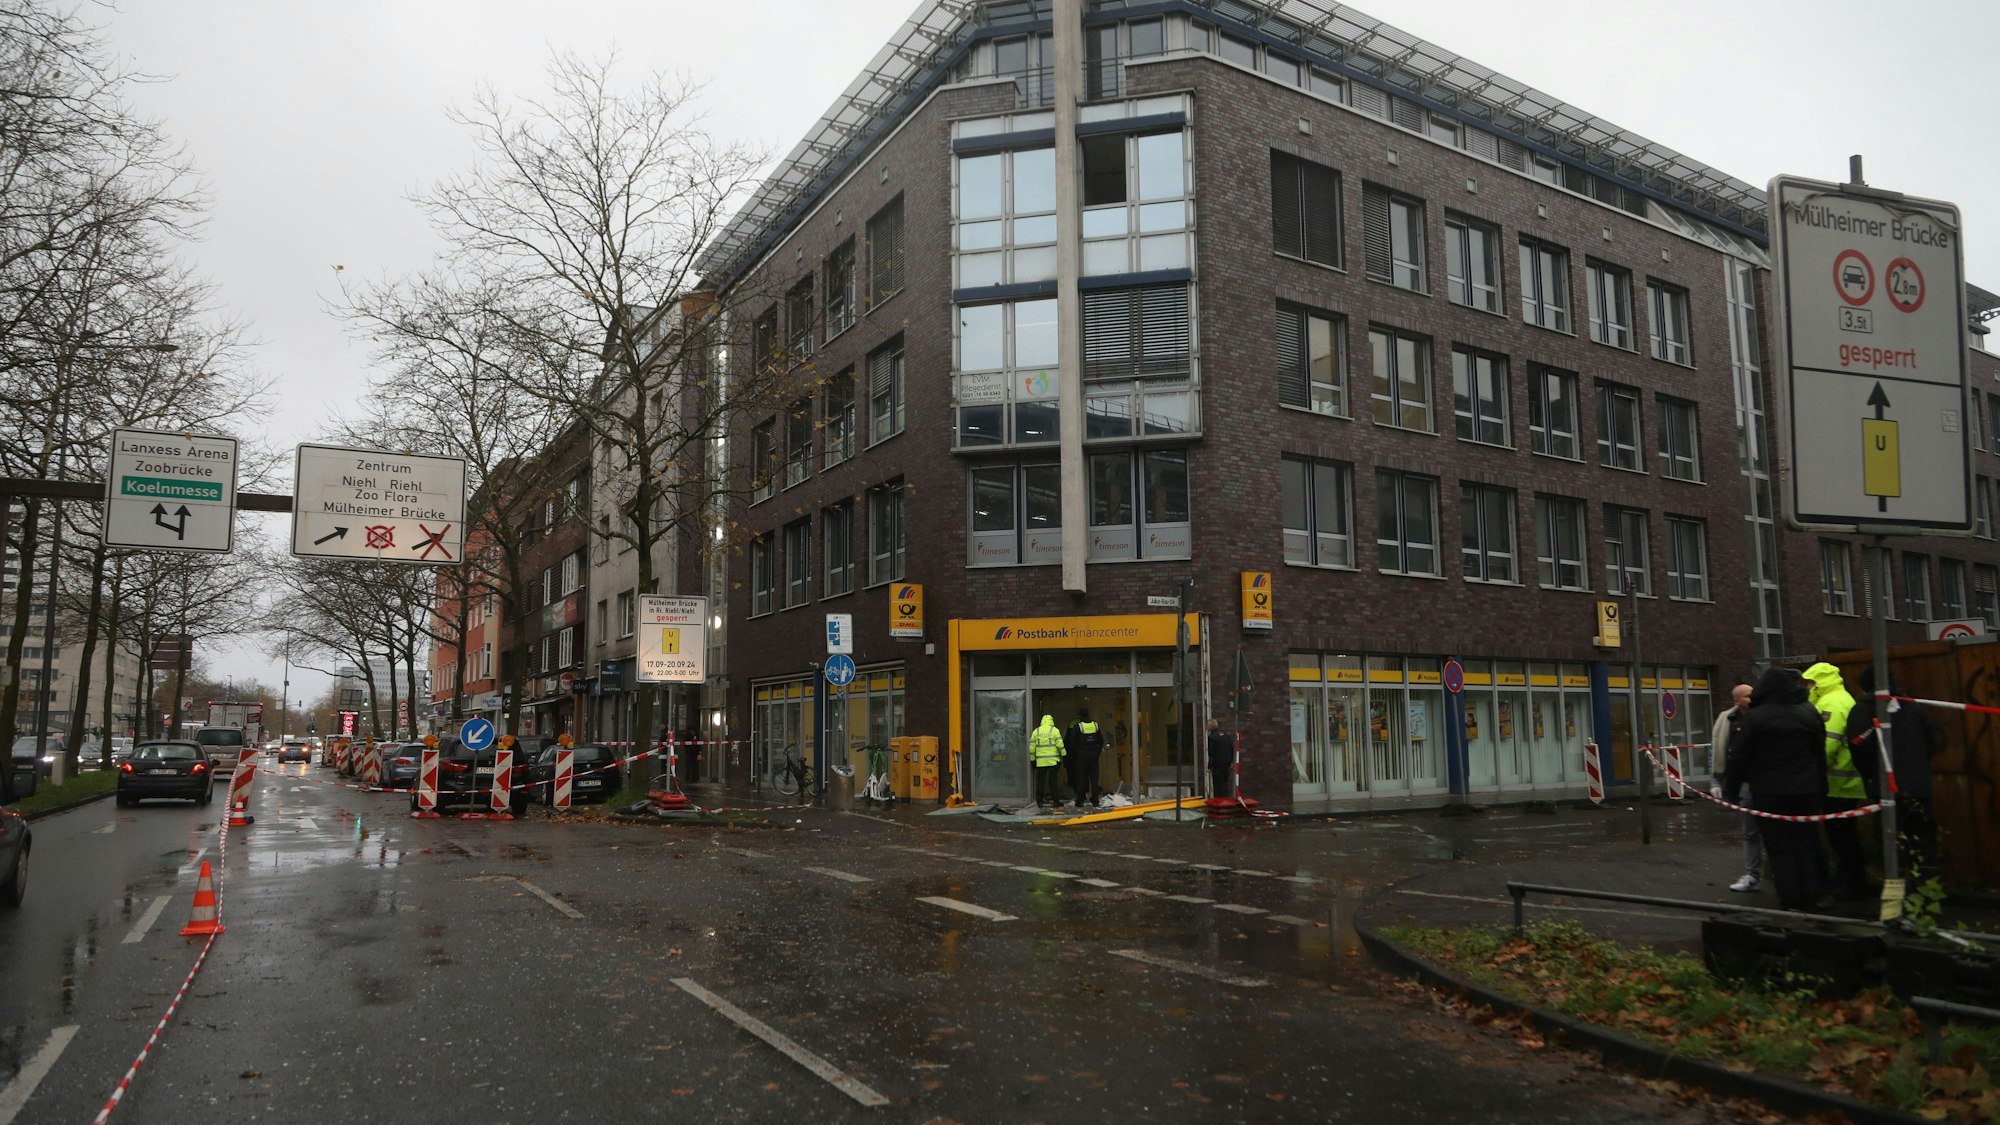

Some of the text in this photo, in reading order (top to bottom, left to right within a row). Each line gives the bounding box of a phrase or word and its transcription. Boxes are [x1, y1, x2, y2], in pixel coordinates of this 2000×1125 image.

[1795, 204, 1948, 249] Mülheimer Brücke
[1839, 343, 1917, 370] gesperrt
[121, 441, 229, 460] Lanxess Arena
[1875, 434, 1886, 451] U
[135, 460, 213, 477] Zoobrücke
[356, 460, 412, 474] Zentrum
[126, 480, 219, 498] Koelnmesse
[342, 476, 422, 492] Niehl Riehl
[355, 489, 418, 504] Zoo Flora
[323, 501, 446, 520] Mülheimer Brücke
[982, 546, 1011, 555] timeson
[1099, 541, 1129, 550] timeson
[1155, 538, 1185, 548] timeson
[1017, 627, 1139, 639] Postbank Finanzcenter
[574, 682, 588, 691] sky
